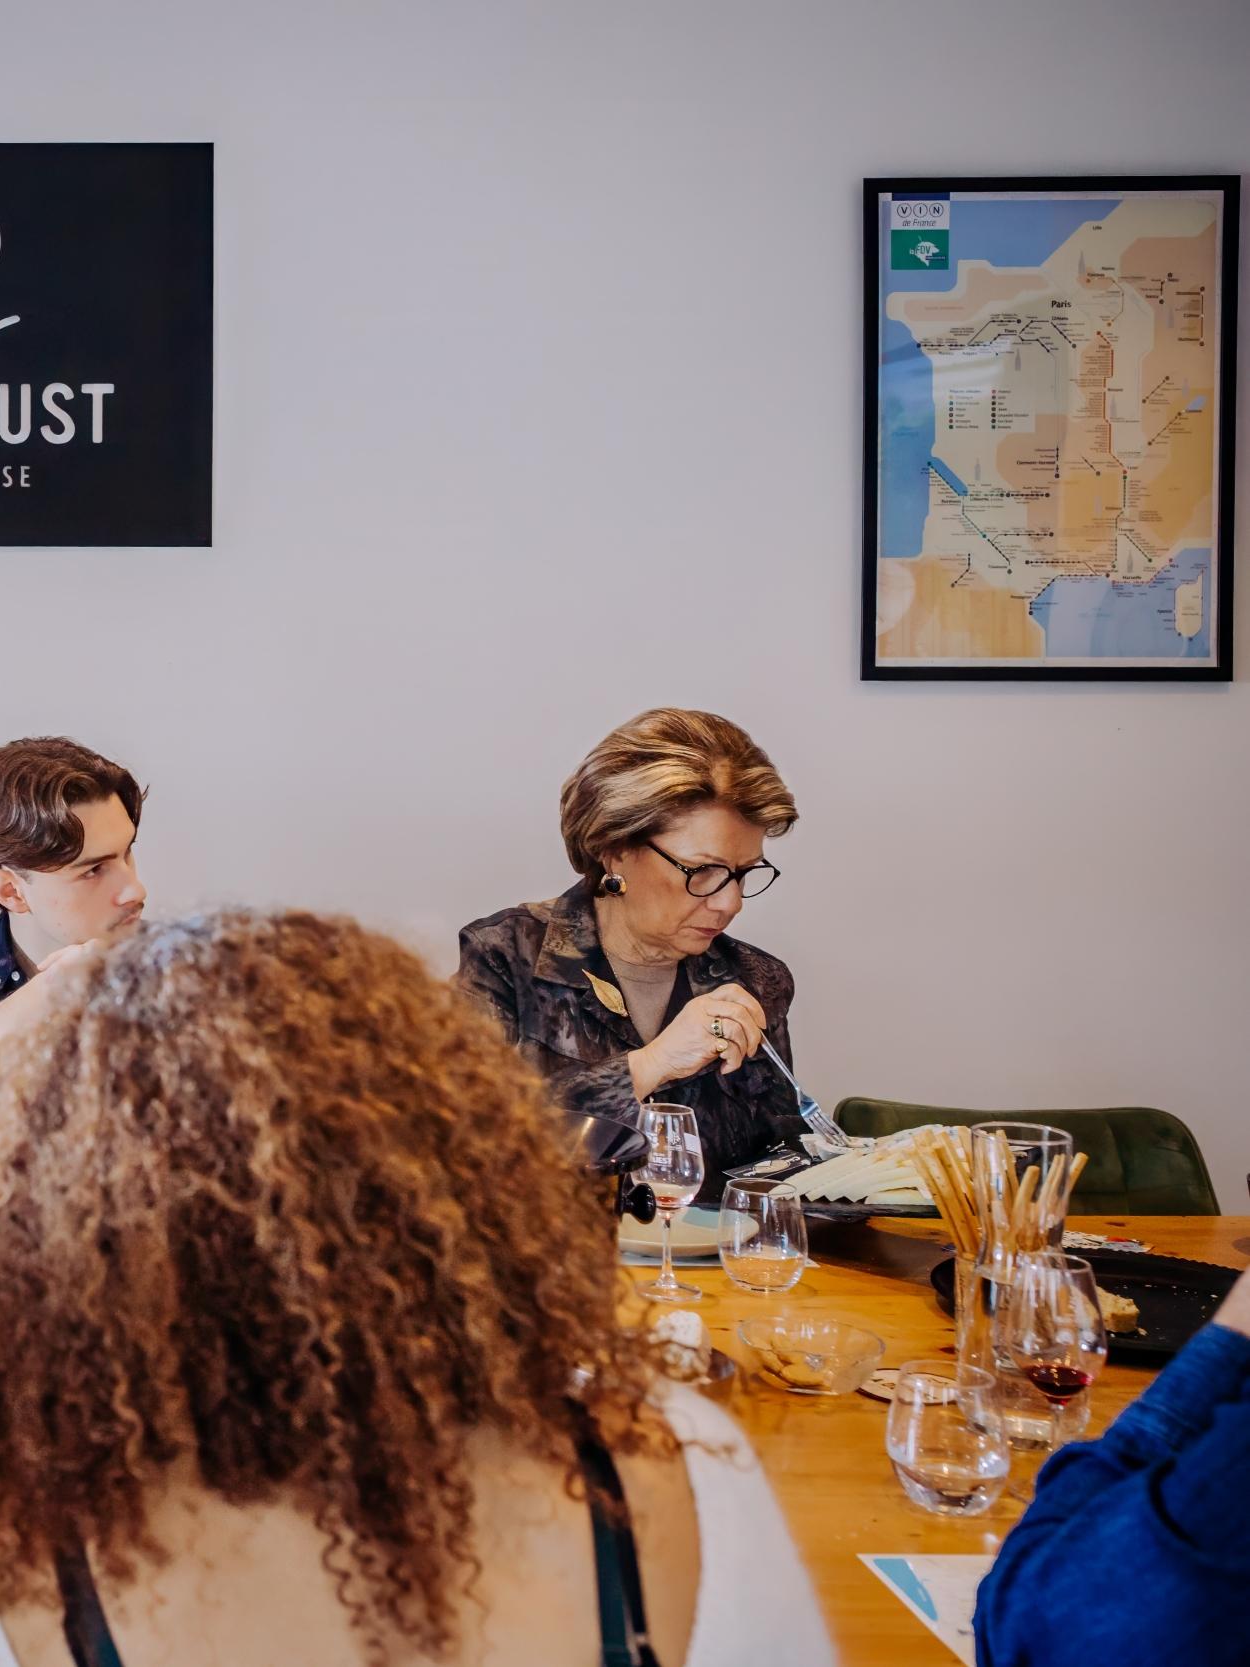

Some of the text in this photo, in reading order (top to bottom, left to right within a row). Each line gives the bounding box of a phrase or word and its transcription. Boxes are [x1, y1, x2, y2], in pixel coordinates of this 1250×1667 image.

[899, 205, 942, 216] VIN
[902, 219, 937, 227] de France
[1051, 300, 1072, 308] Paris
